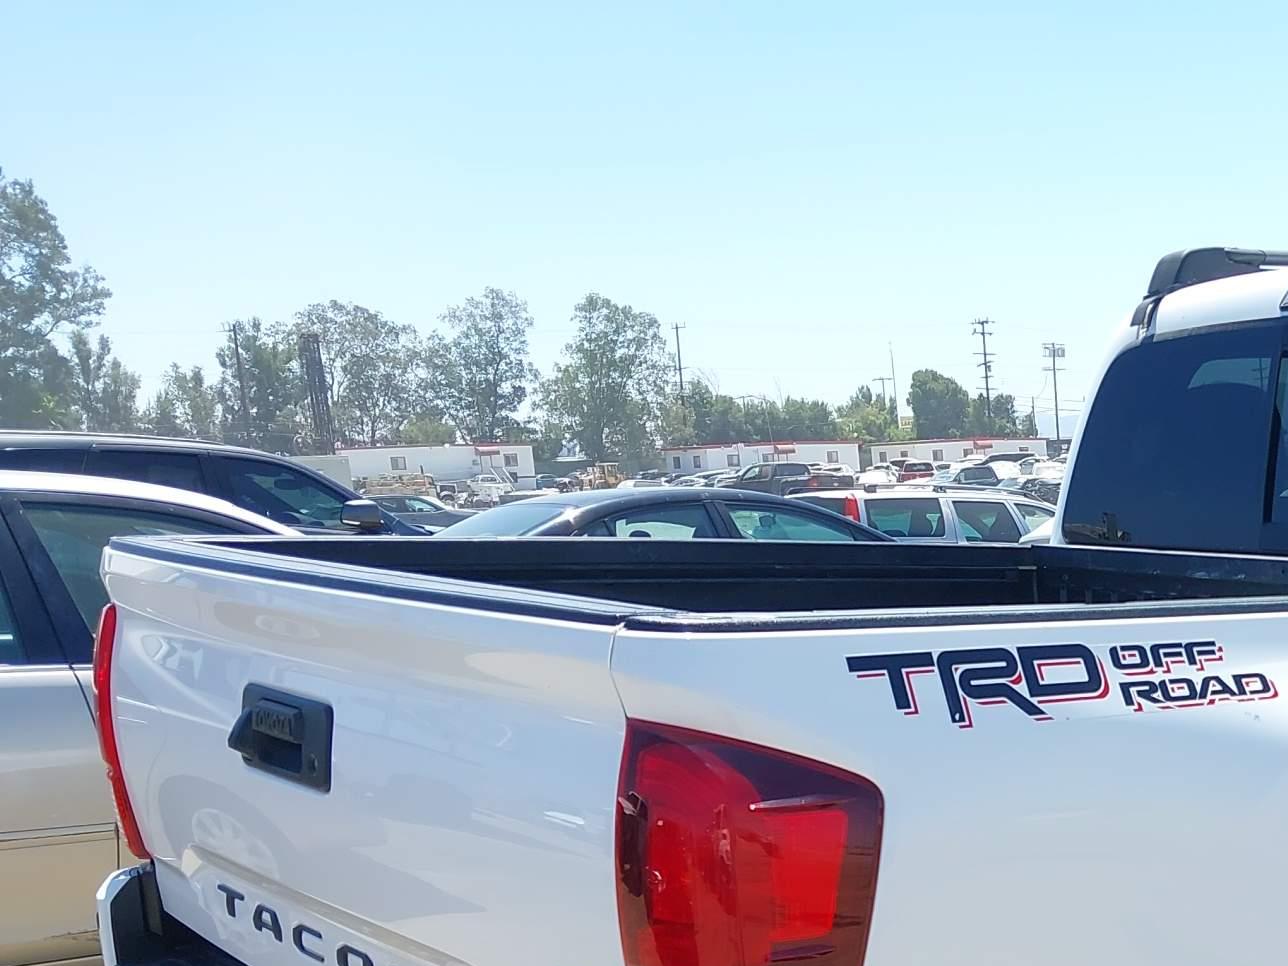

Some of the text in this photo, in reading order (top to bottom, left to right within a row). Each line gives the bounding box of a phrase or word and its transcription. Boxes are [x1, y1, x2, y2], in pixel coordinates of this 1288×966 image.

[1109, 640, 1223, 676] OFF
[846, 643, 1110, 729] TRD
[1119, 672, 1278, 712] ROAD
